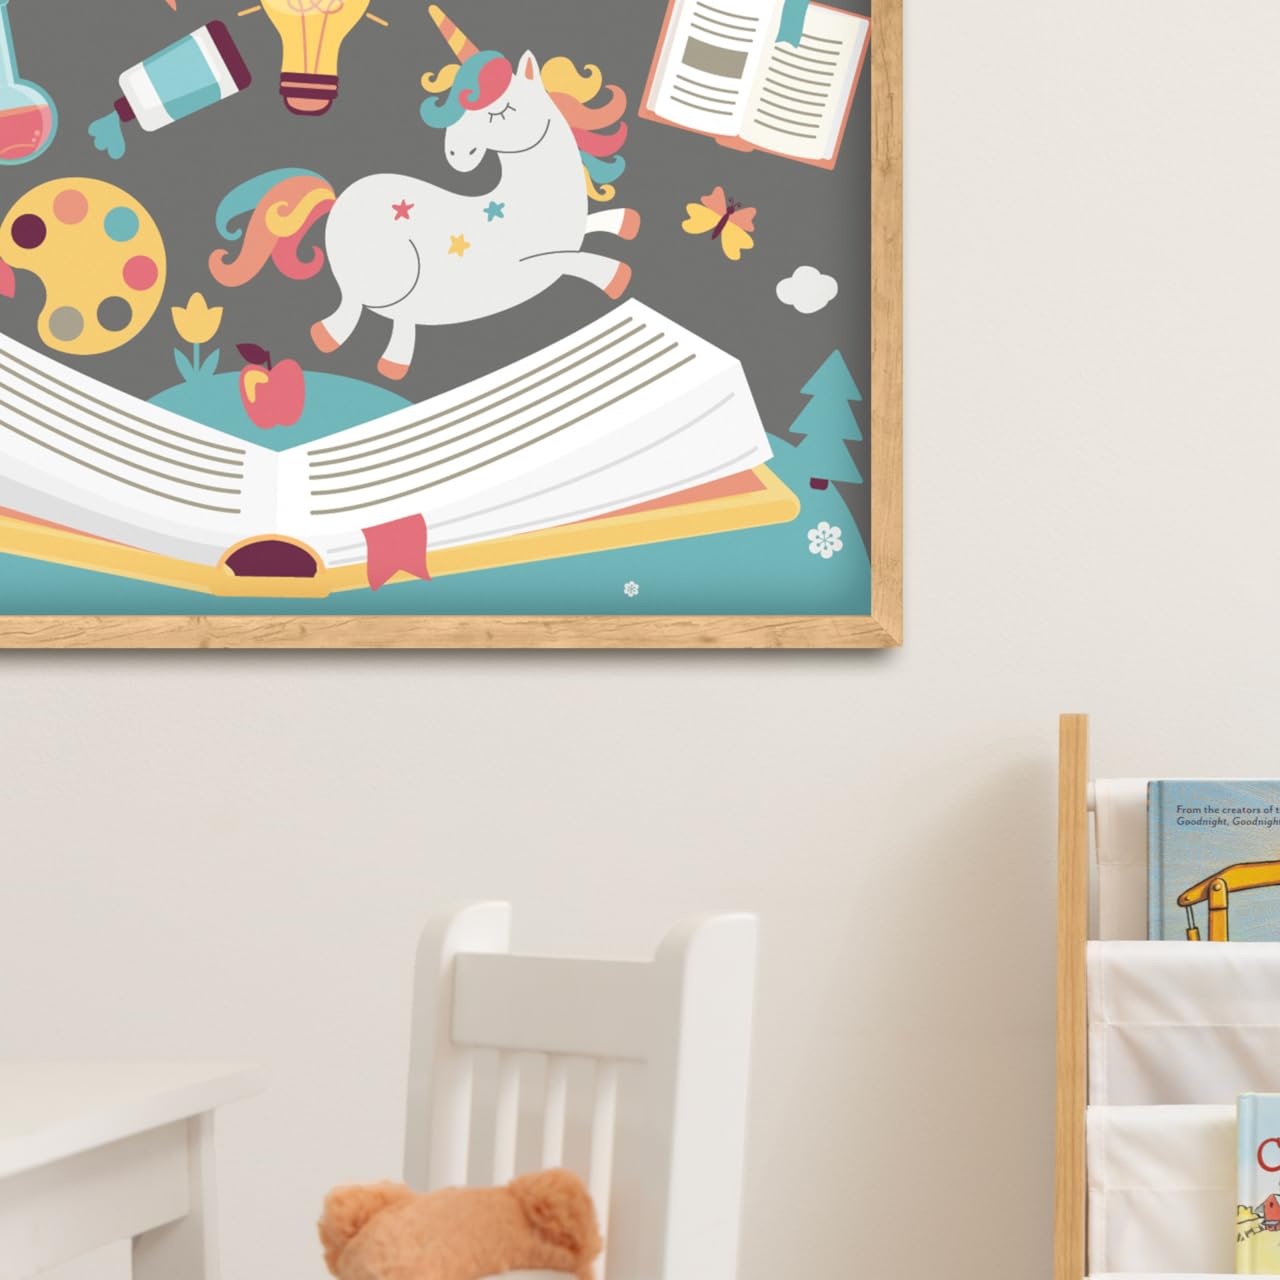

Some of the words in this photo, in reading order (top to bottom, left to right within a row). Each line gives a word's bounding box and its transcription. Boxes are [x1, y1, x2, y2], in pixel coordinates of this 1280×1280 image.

[1176, 805, 1201, 814] From
[1204, 805, 1220, 814] the
[1222, 806, 1261, 814] creators
[1263, 804, 1273, 814] of
[1176, 816, 1230, 828] Goodnight,
